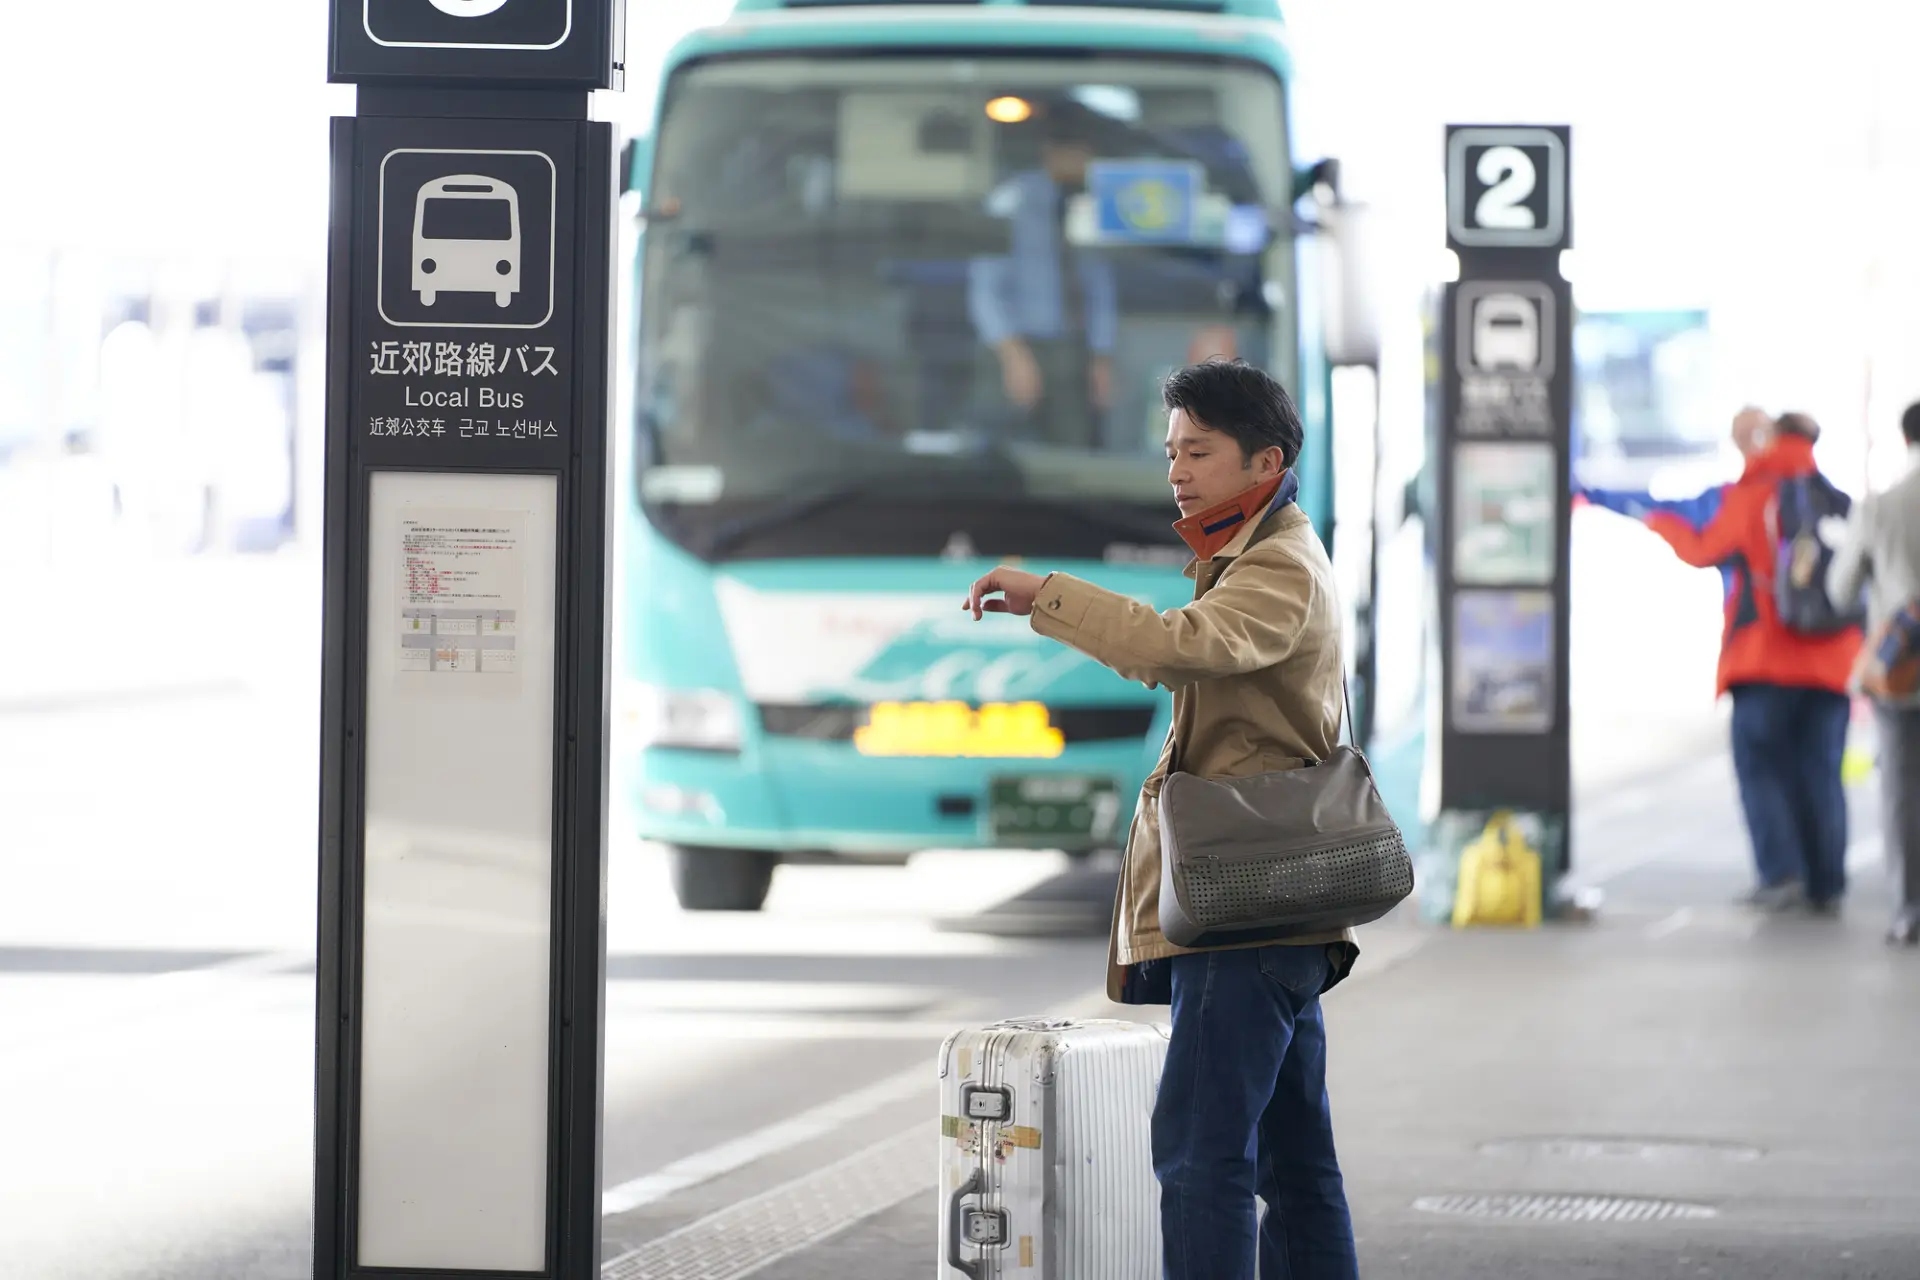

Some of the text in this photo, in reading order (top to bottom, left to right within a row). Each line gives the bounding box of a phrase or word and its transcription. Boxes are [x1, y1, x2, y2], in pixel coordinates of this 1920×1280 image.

[1476, 146, 1536, 230] 2
[370, 340, 559, 378] 近郊路線バス
[405, 386, 524, 408] Local Bus
[369, 416, 447, 438] 近郊公交车
[458, 418, 558, 439] 근교 노선버스
